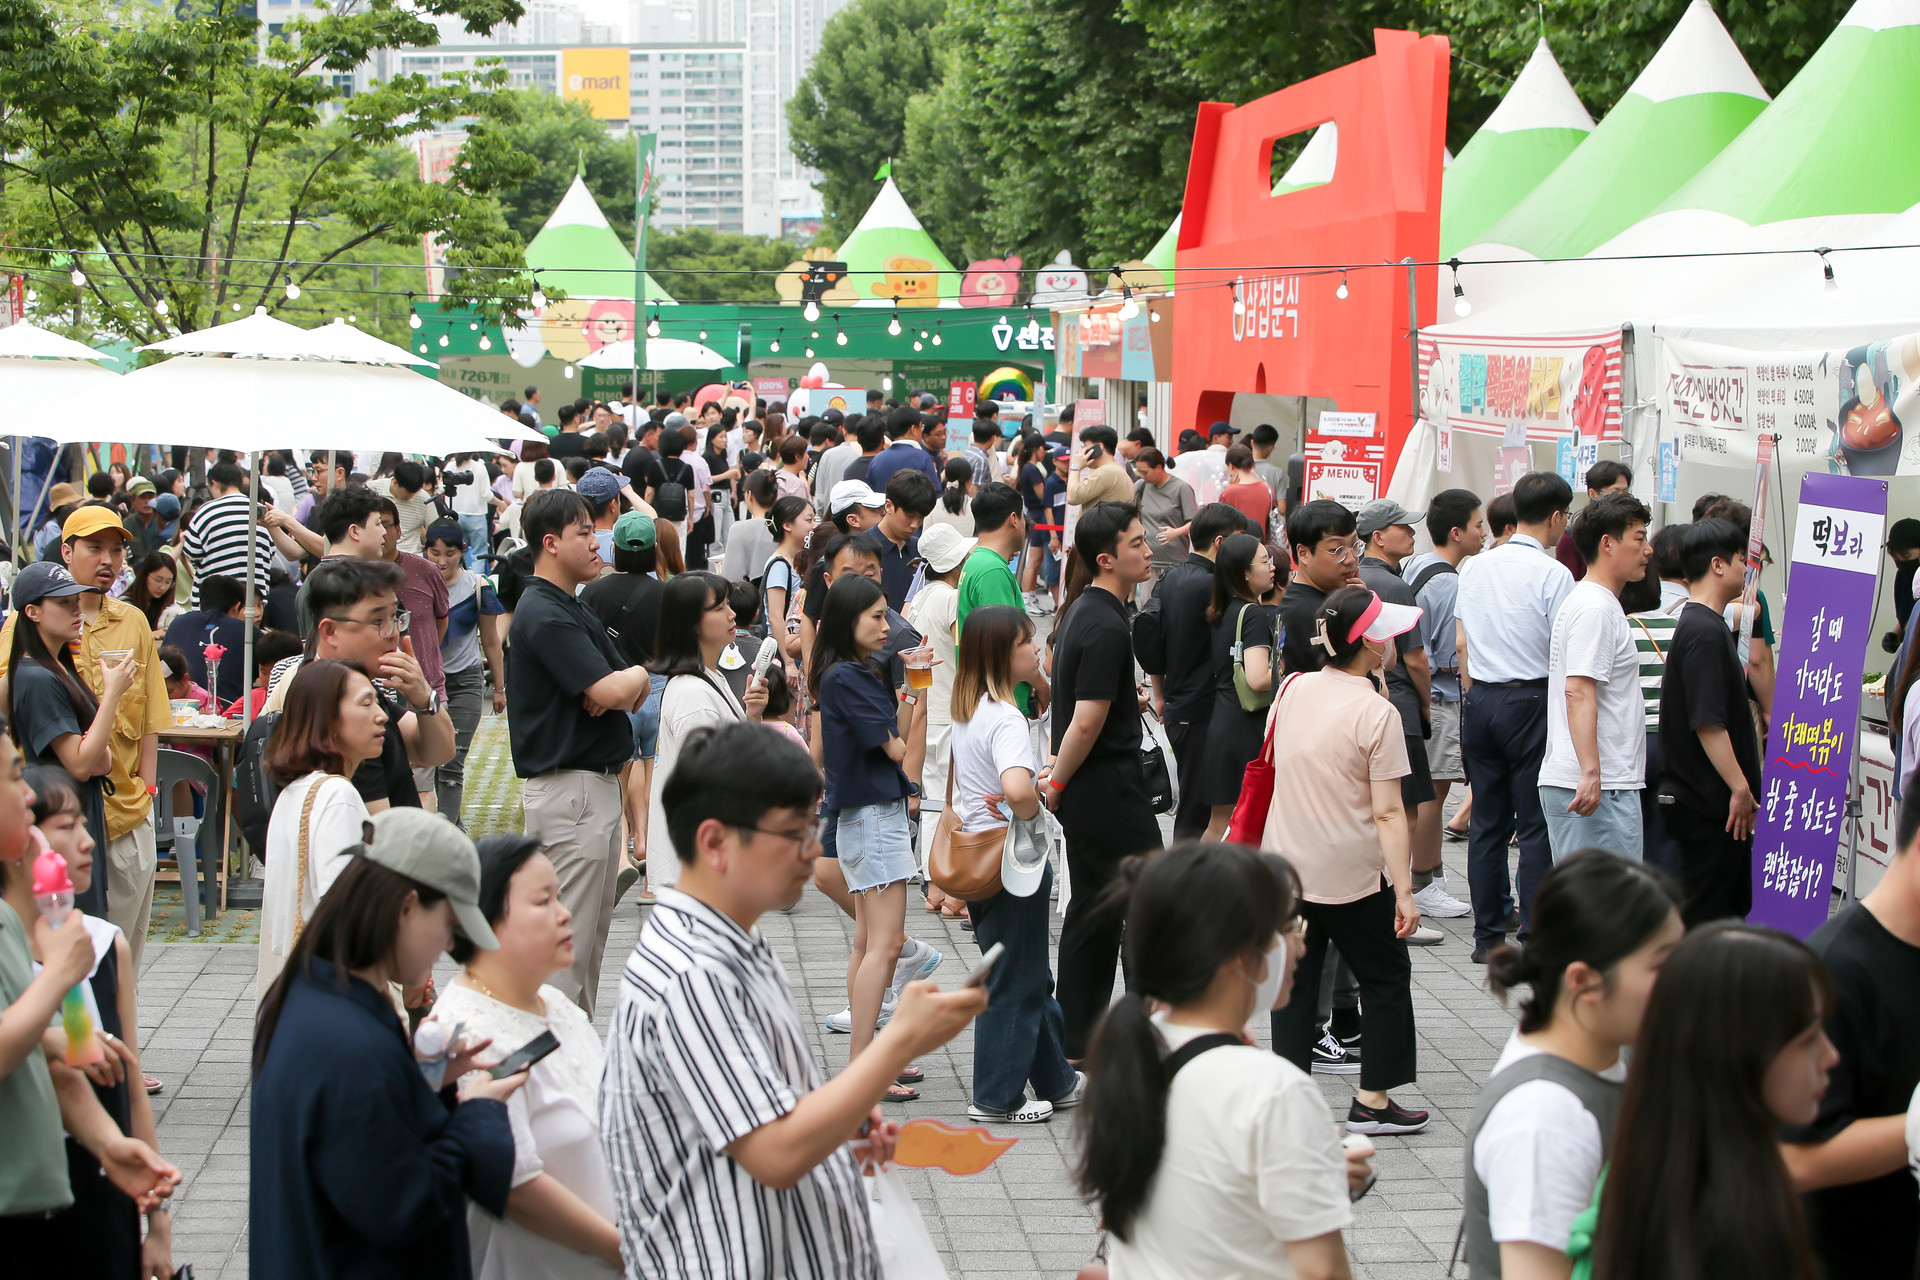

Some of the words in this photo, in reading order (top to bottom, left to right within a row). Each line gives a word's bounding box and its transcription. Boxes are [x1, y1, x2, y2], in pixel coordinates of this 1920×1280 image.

[569, 75, 621, 91] emart
[1246, 276, 1299, 339] 삼첩분식
[1793, 363, 1814, 382] 4,500원
[758, 381, 784, 390] 100%
[1794, 388, 1815, 407] 4,500원
[1794, 413, 1817, 431] 4,000원
[1796, 437, 1818, 455] 3,000원
[1327, 469, 1359, 479] MENU
[1812, 515, 1863, 559] 떡보라
[1811, 606, 1826, 653] 갈
[1828, 616, 1844, 643] 때
[1795, 658, 1844, 706] 가더라도
[1782, 712, 1844, 766] 가래떡볶이
[1766, 777, 1781, 822] 한
[1783, 780, 1798, 832] 줄
[1801, 788, 1837, 835] 정도는
[1762, 841, 1823, 900] 괜찮잖아?
[1006, 1111, 1040, 1121] crocs
